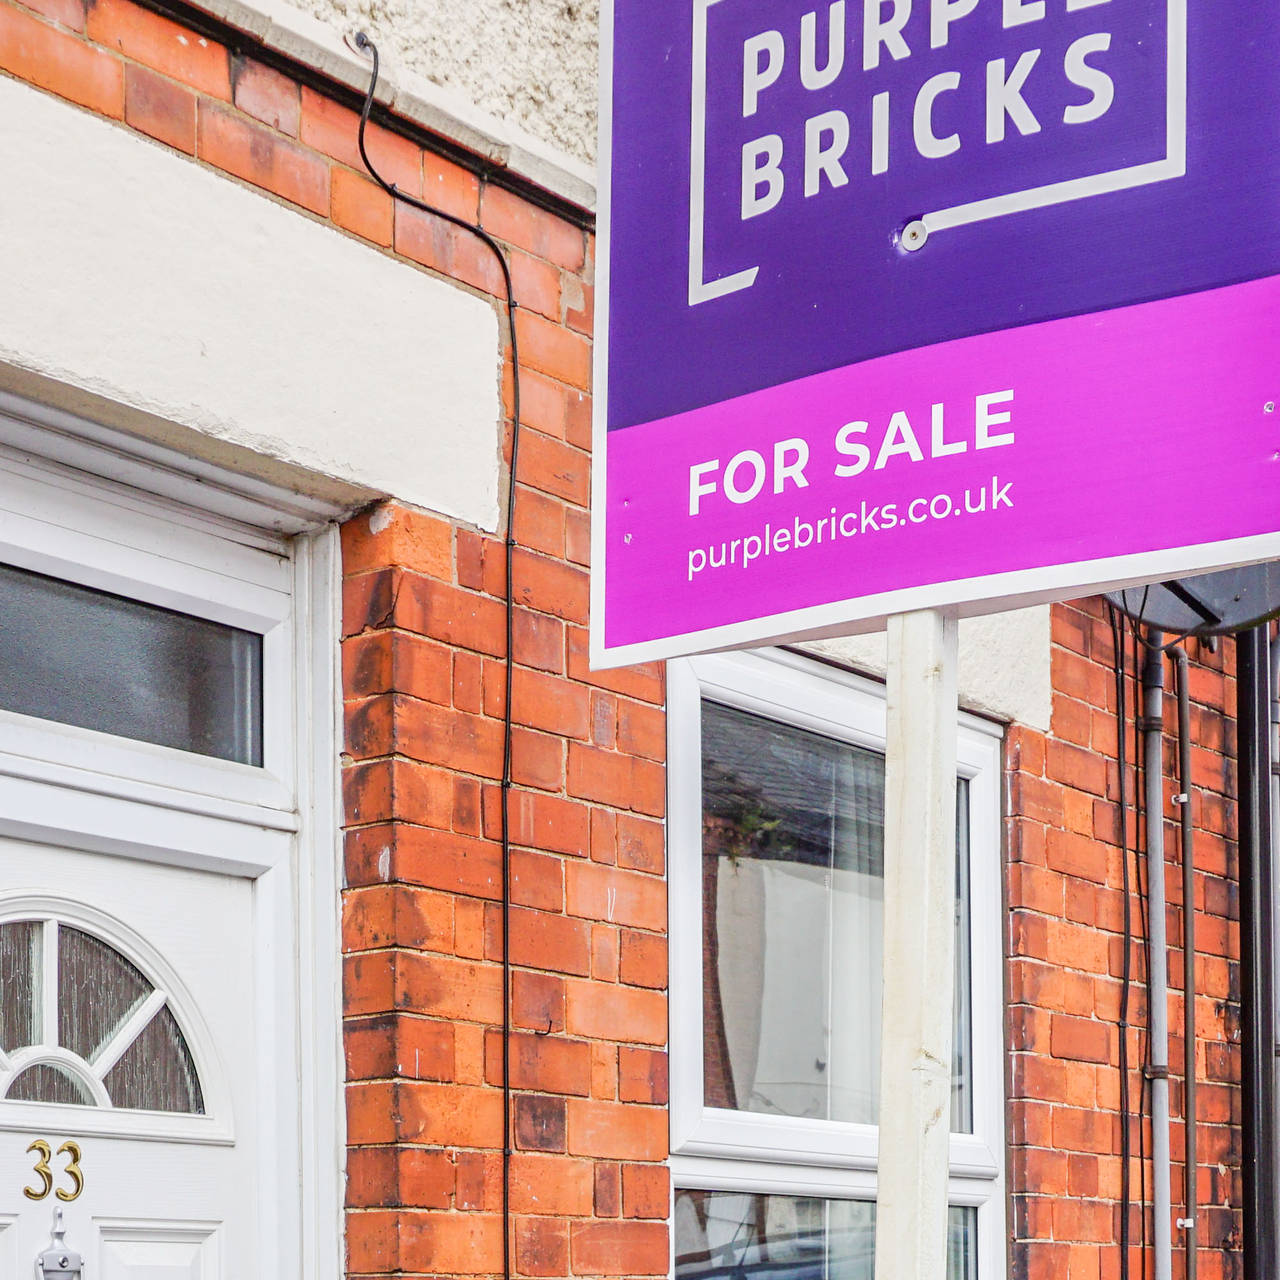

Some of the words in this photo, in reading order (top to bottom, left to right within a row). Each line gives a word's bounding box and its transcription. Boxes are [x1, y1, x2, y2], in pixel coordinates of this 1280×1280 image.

[742, 0, 1113, 118] PURP
[740, 32, 1115, 221] BRICKS
[688, 437, 810, 516] FOR
[834, 388, 1015, 478] SALE
[687, 475, 1014, 582] purplebricks.co.uk
[23, 1138, 85, 1202] 33
